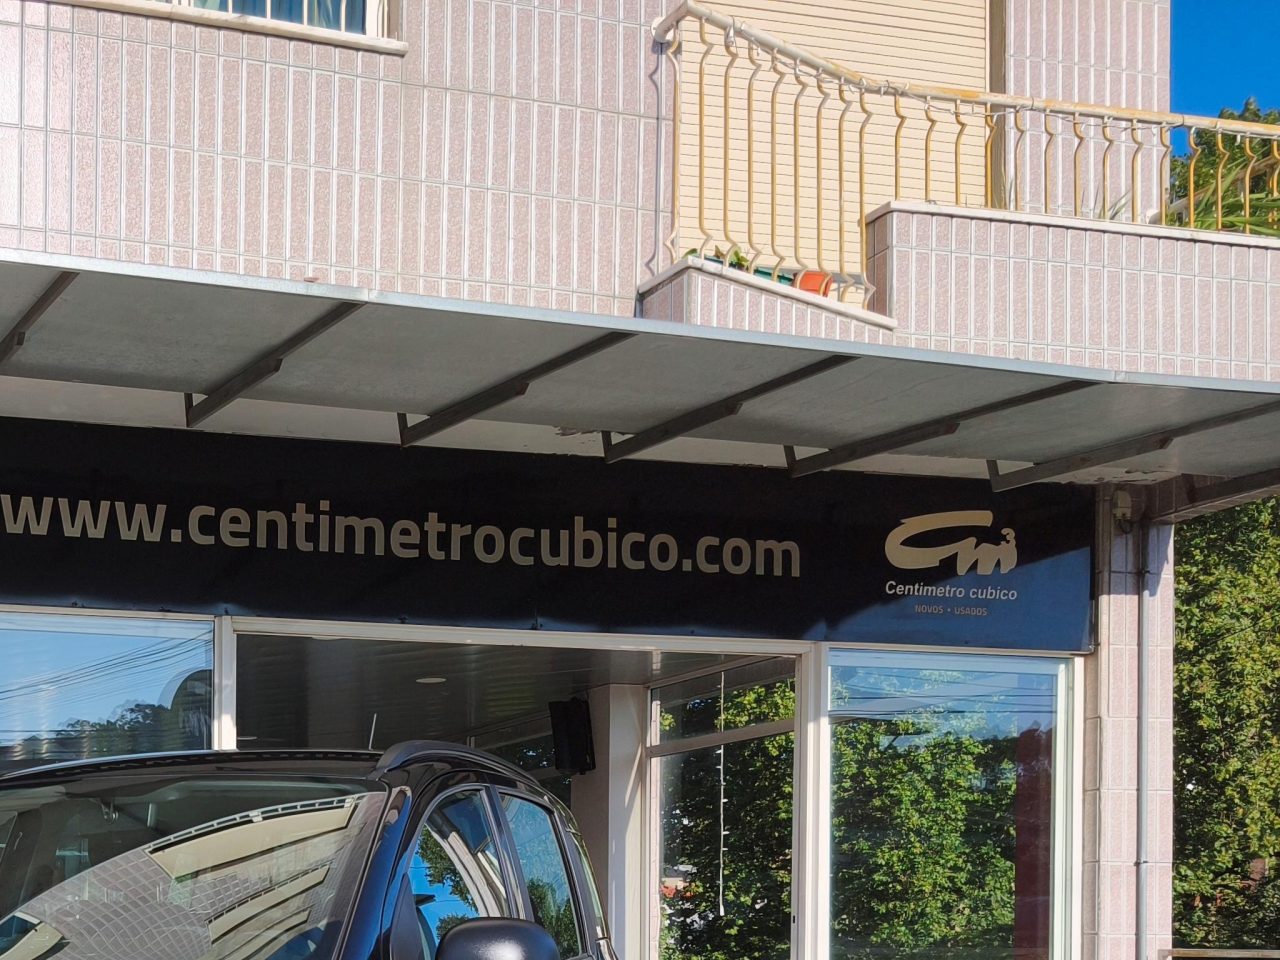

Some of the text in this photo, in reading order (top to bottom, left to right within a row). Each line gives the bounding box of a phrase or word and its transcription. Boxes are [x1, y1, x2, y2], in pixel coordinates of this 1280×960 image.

[0, 494, 802, 578] www.centimetrocubico.com
[885, 580, 1018, 600] Centimetro cubico
[915, 604, 988, 616] NOVOS USADOS
